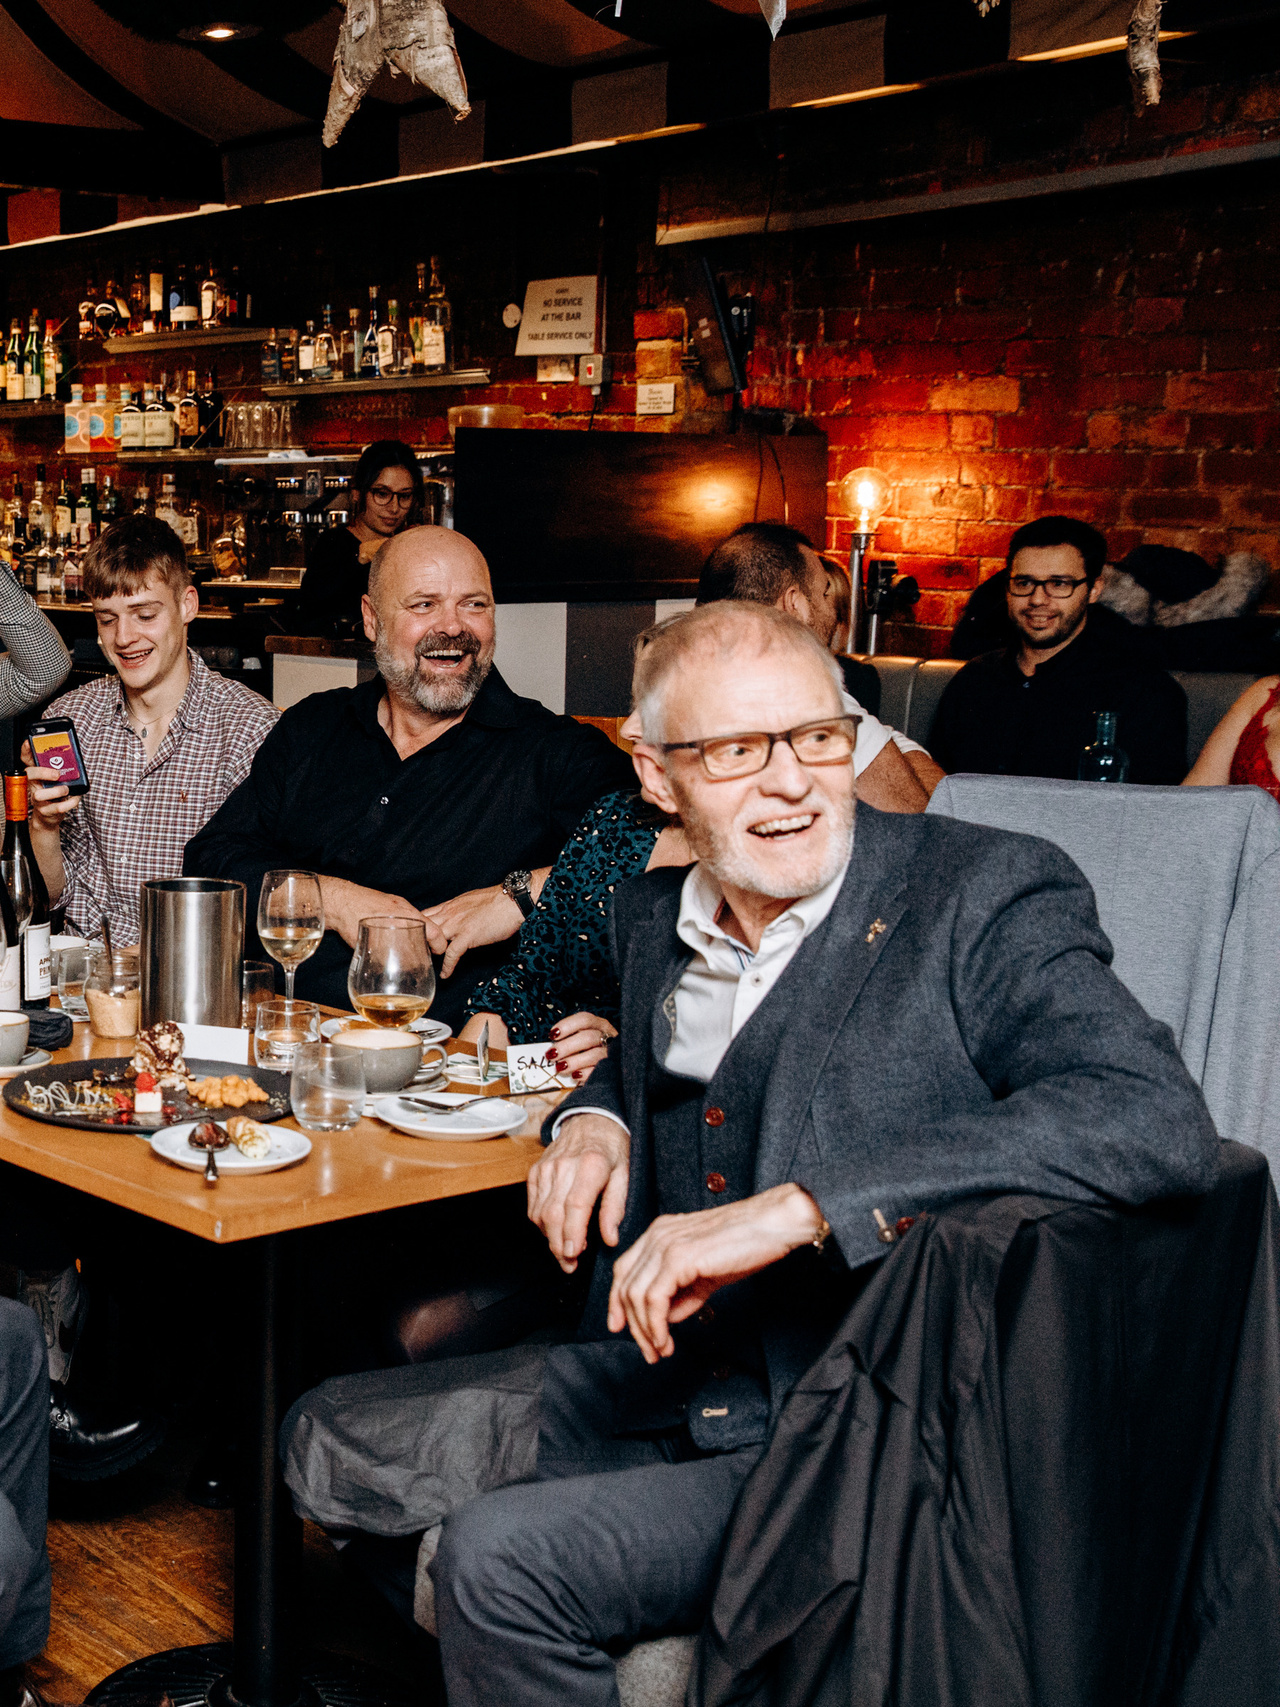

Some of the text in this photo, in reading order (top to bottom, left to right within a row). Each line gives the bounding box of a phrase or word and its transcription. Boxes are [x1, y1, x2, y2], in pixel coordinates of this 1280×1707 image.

[553, 297, 583, 306] SERVICE
[541, 311, 581, 322] AT THE BAR
[528, 332, 593, 341] TABLE SERVICE ONLY
